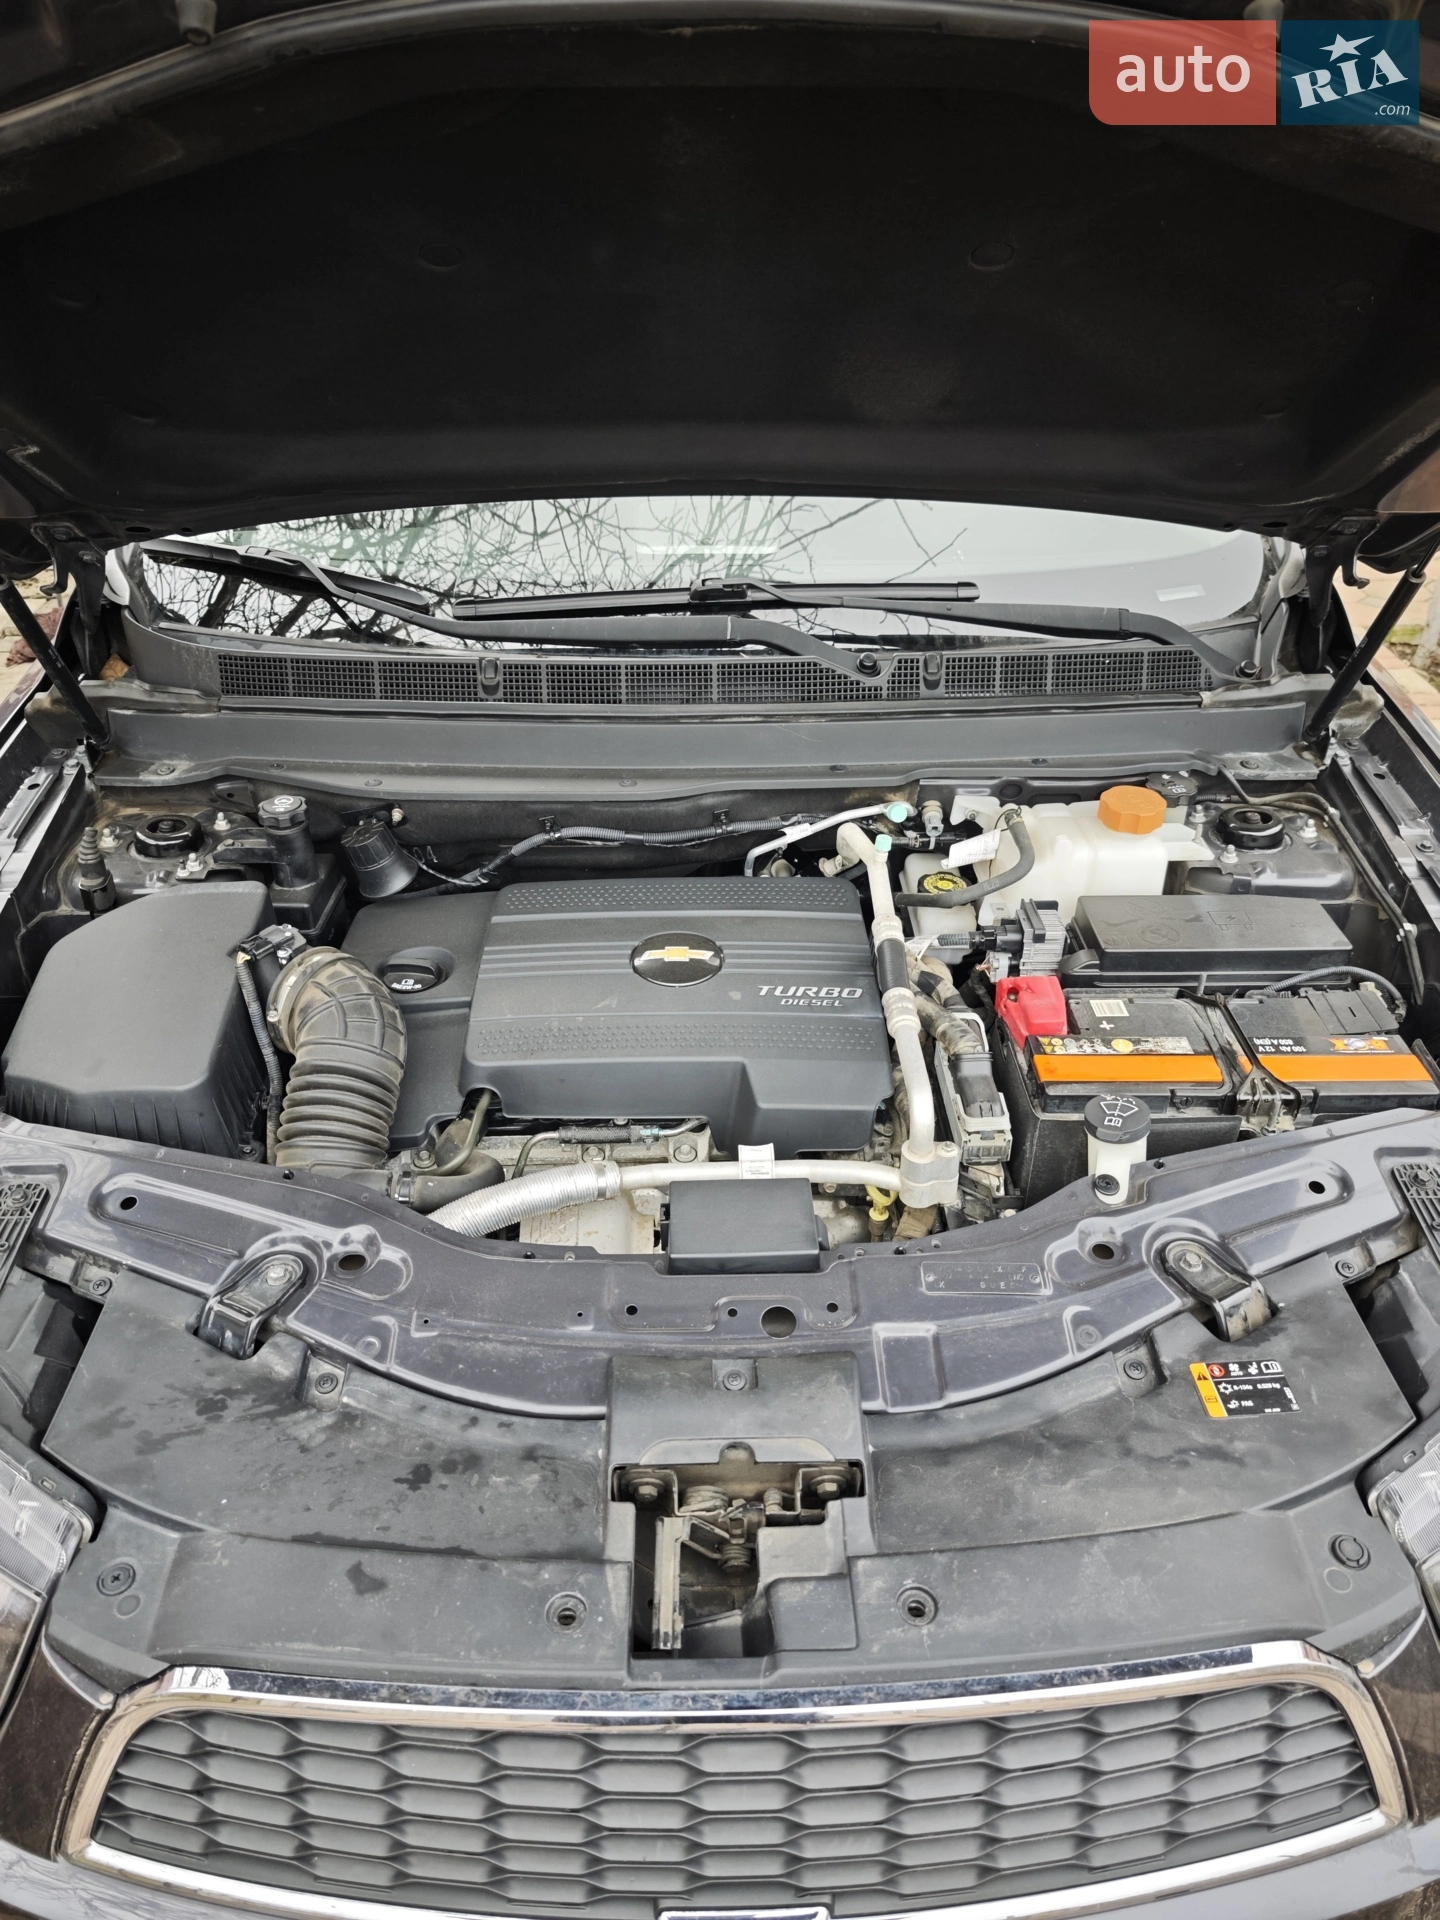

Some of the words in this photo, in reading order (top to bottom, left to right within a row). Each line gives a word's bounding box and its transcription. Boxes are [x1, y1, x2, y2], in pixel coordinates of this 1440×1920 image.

[757, 985, 863, 999] TURBO
[780, 998, 843, 1007] DIESEL
[1279, 1045, 1291, 1053] Ah
[1291, 1045, 1307, 1053] 100
